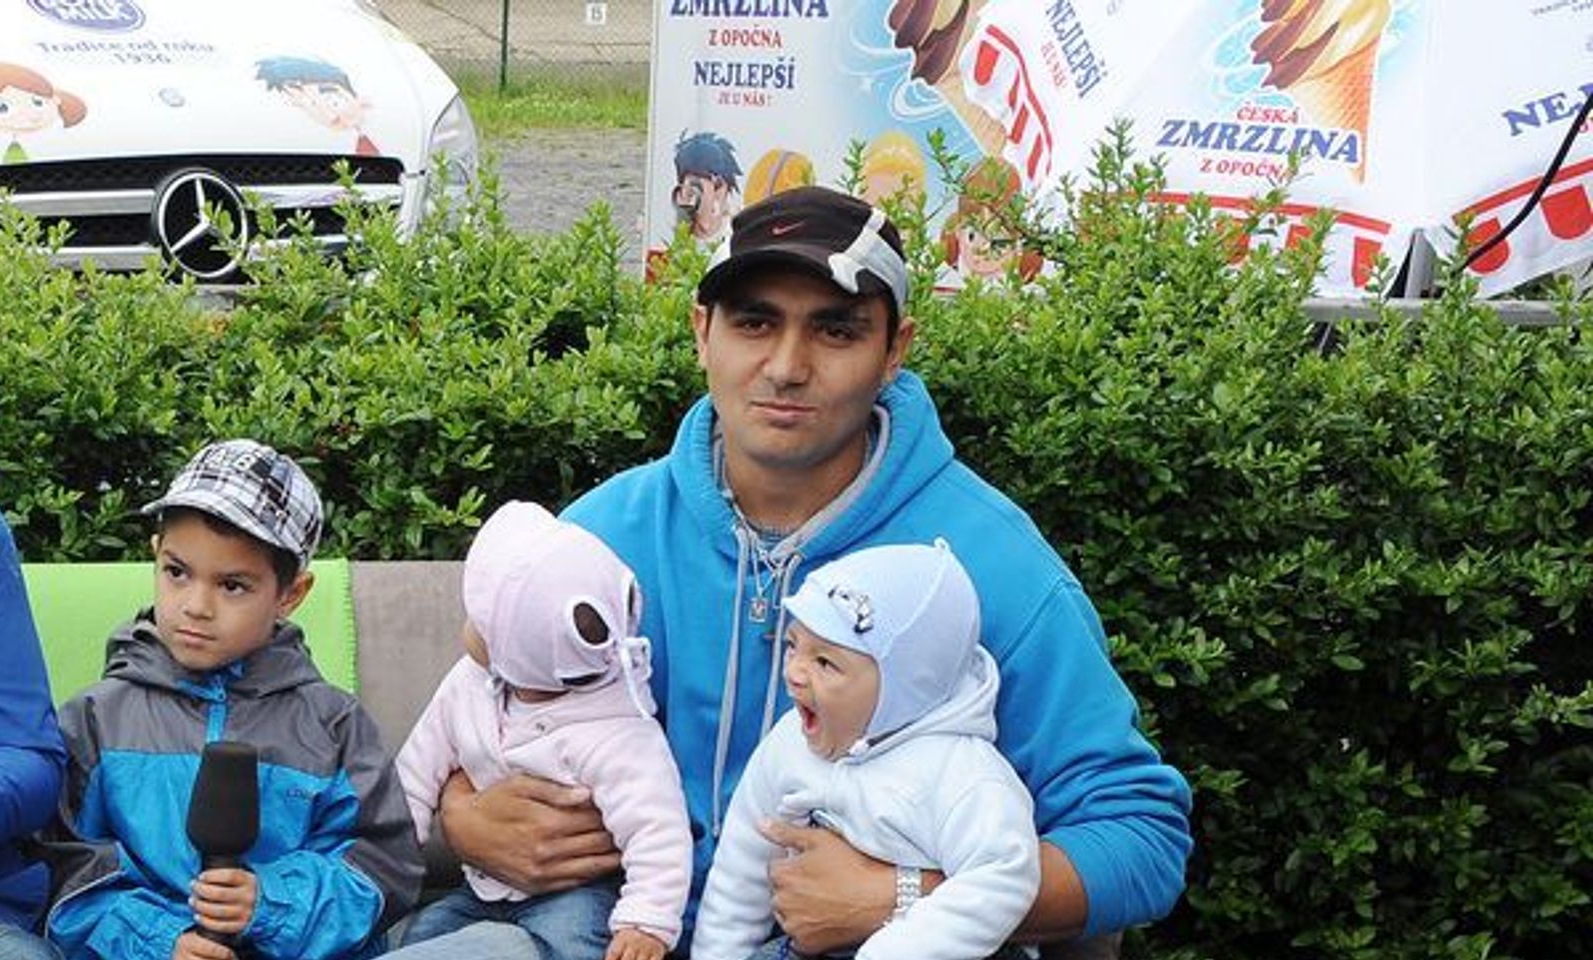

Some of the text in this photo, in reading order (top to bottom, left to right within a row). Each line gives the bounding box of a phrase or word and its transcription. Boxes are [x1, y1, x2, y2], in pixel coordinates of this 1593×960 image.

[671, 0, 829, 17] ZMRZLINA
[721, 24, 783, 48] OPOČNA
[1046, 0, 1108, 98] NEJLEPŠÍ
[694, 56, 795, 89] NEJLEPŠÍ
[1237, 101, 1300, 124] ČESKÁ
[1156, 119, 1360, 163] ZMRZLINA
[1200, 158, 1214, 173] Z
